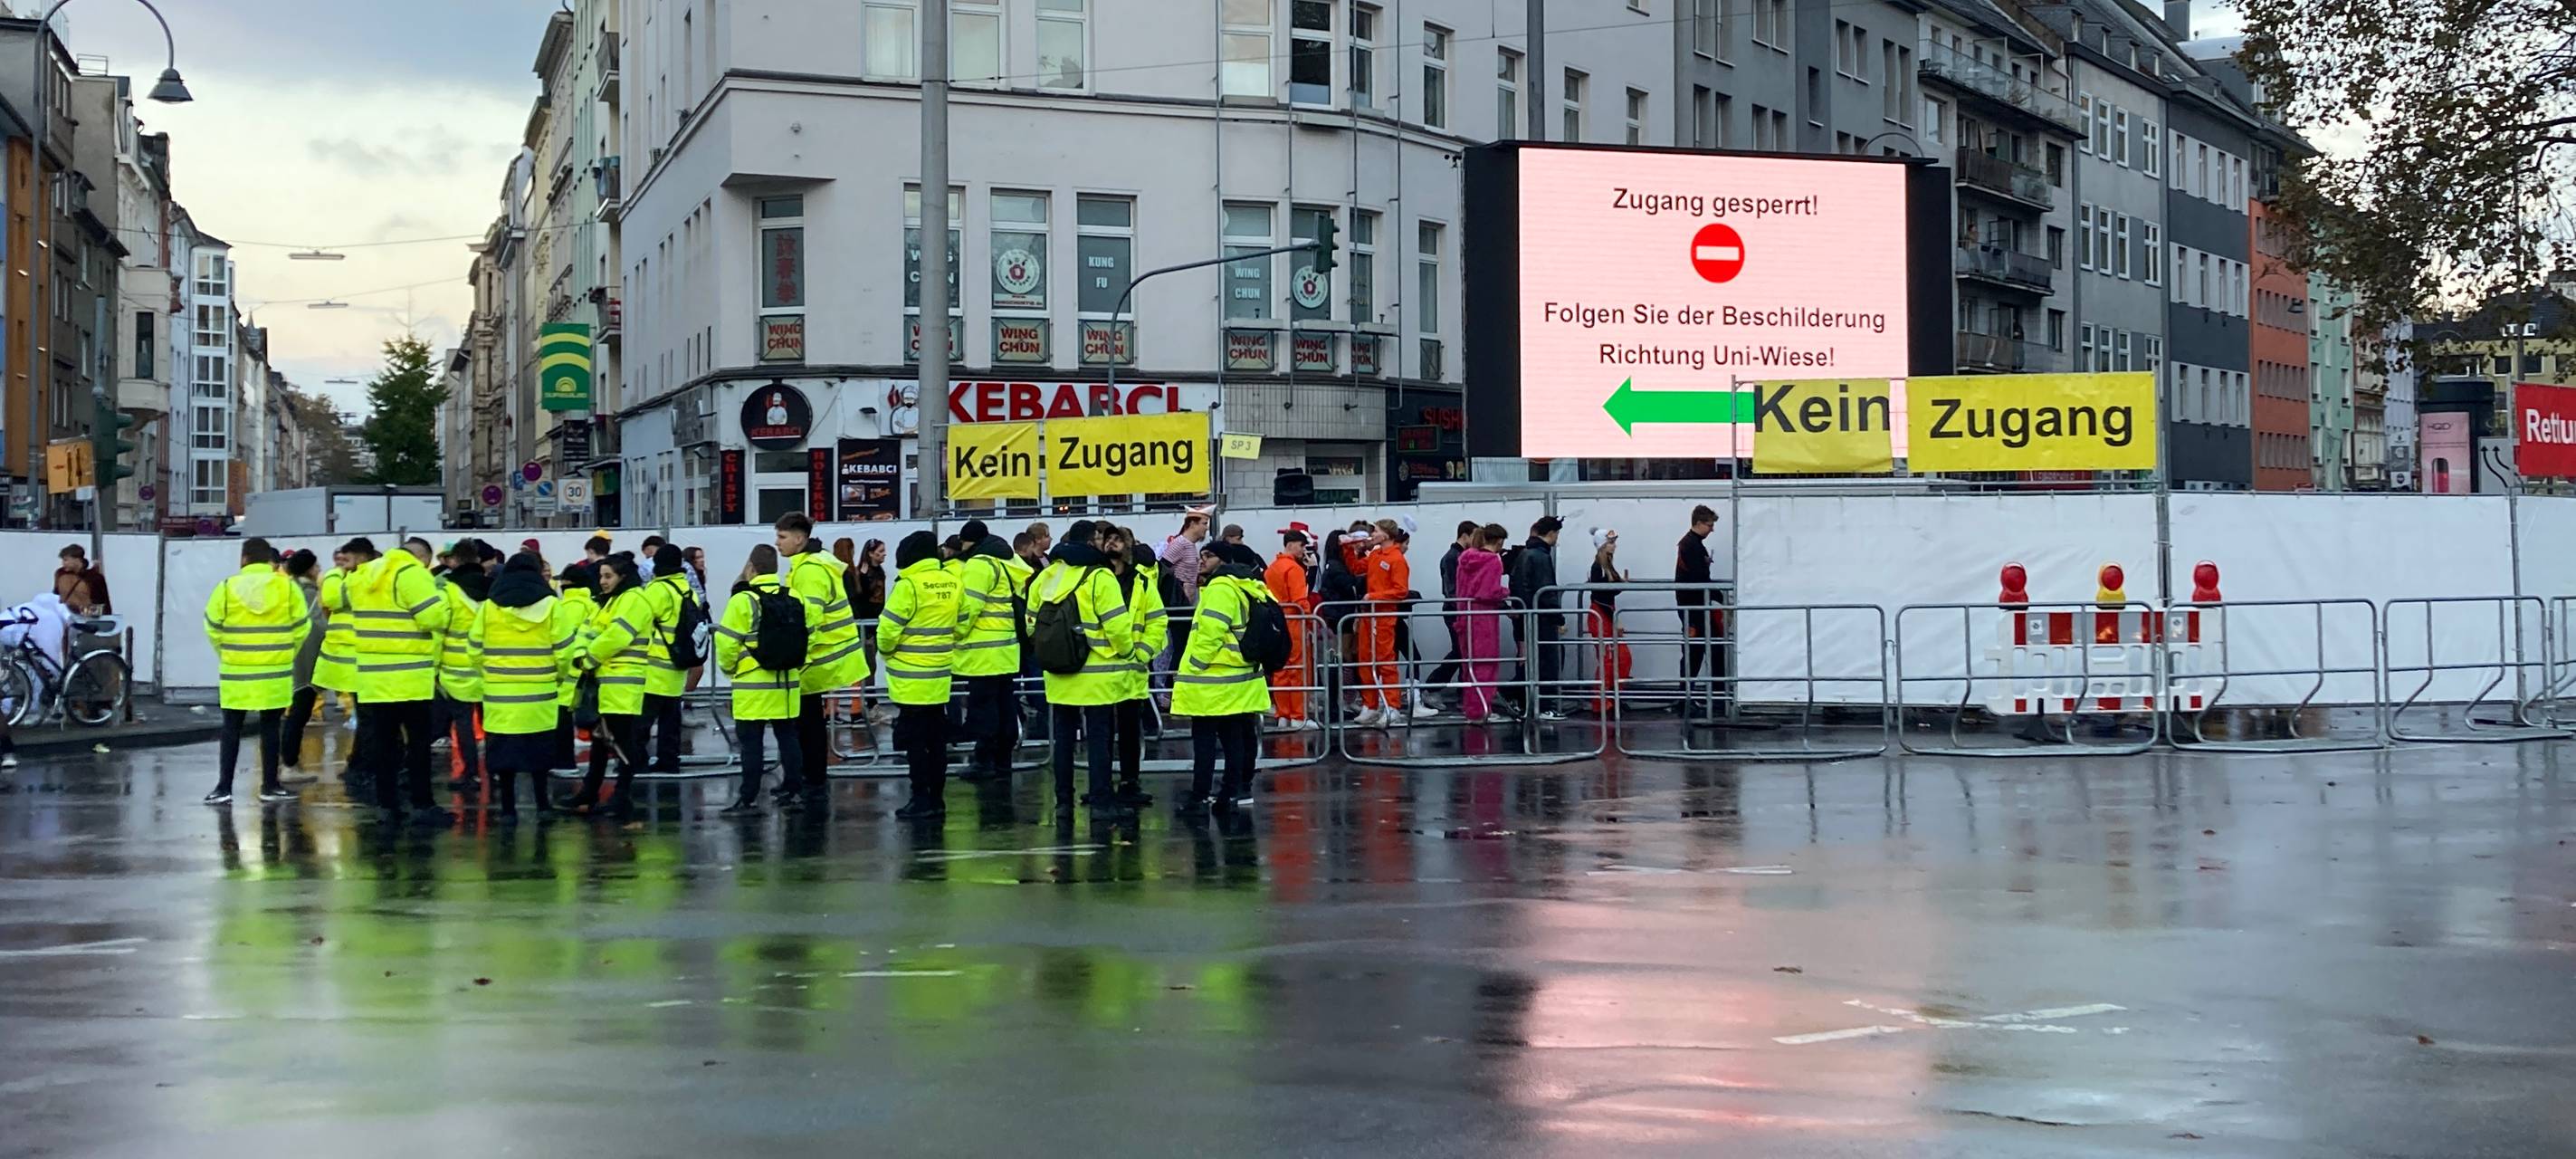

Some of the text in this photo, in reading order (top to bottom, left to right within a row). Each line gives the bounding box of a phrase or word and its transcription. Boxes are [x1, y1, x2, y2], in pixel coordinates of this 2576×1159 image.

[1612, 188, 1818, 219] Zugang gesperrt!
[1088, 256, 1114, 268] KUNG
[1235, 267, 1260, 279] WING
[1095, 277, 1108, 288] FU
[1235, 288, 1261, 299] CHUN
[1544, 302, 1885, 333] Folgen Sie der Beschilderung
[1000, 328, 1038, 340] WING
[1086, 330, 1123, 341] WING
[1230, 335, 1265, 347] WING
[1295, 339, 1327, 350] WING
[999, 341, 1040, 354] CHUN
[1229, 349, 1267, 359] CHUN
[1295, 351, 1328, 363] CHUN
[1598, 343, 1835, 370] Richtung Uni-Wiese!
[949, 382, 1179, 423] KEBABCI
[1754, 383, 1890, 434] Kein
[1930, 398, 2133, 447] Zugang
[2525, 408, 2576, 445] Rettu
[1230, 440, 1252, 451] SP 3
[955, 445, 1031, 478] Kein
[1058, 436, 1193, 477] Zugang
[849, 465, 897, 474] KEBABCI
[725, 453, 738, 513] CRISPY
[568, 486, 582, 498] 30
[922, 581, 957, 589] Security
